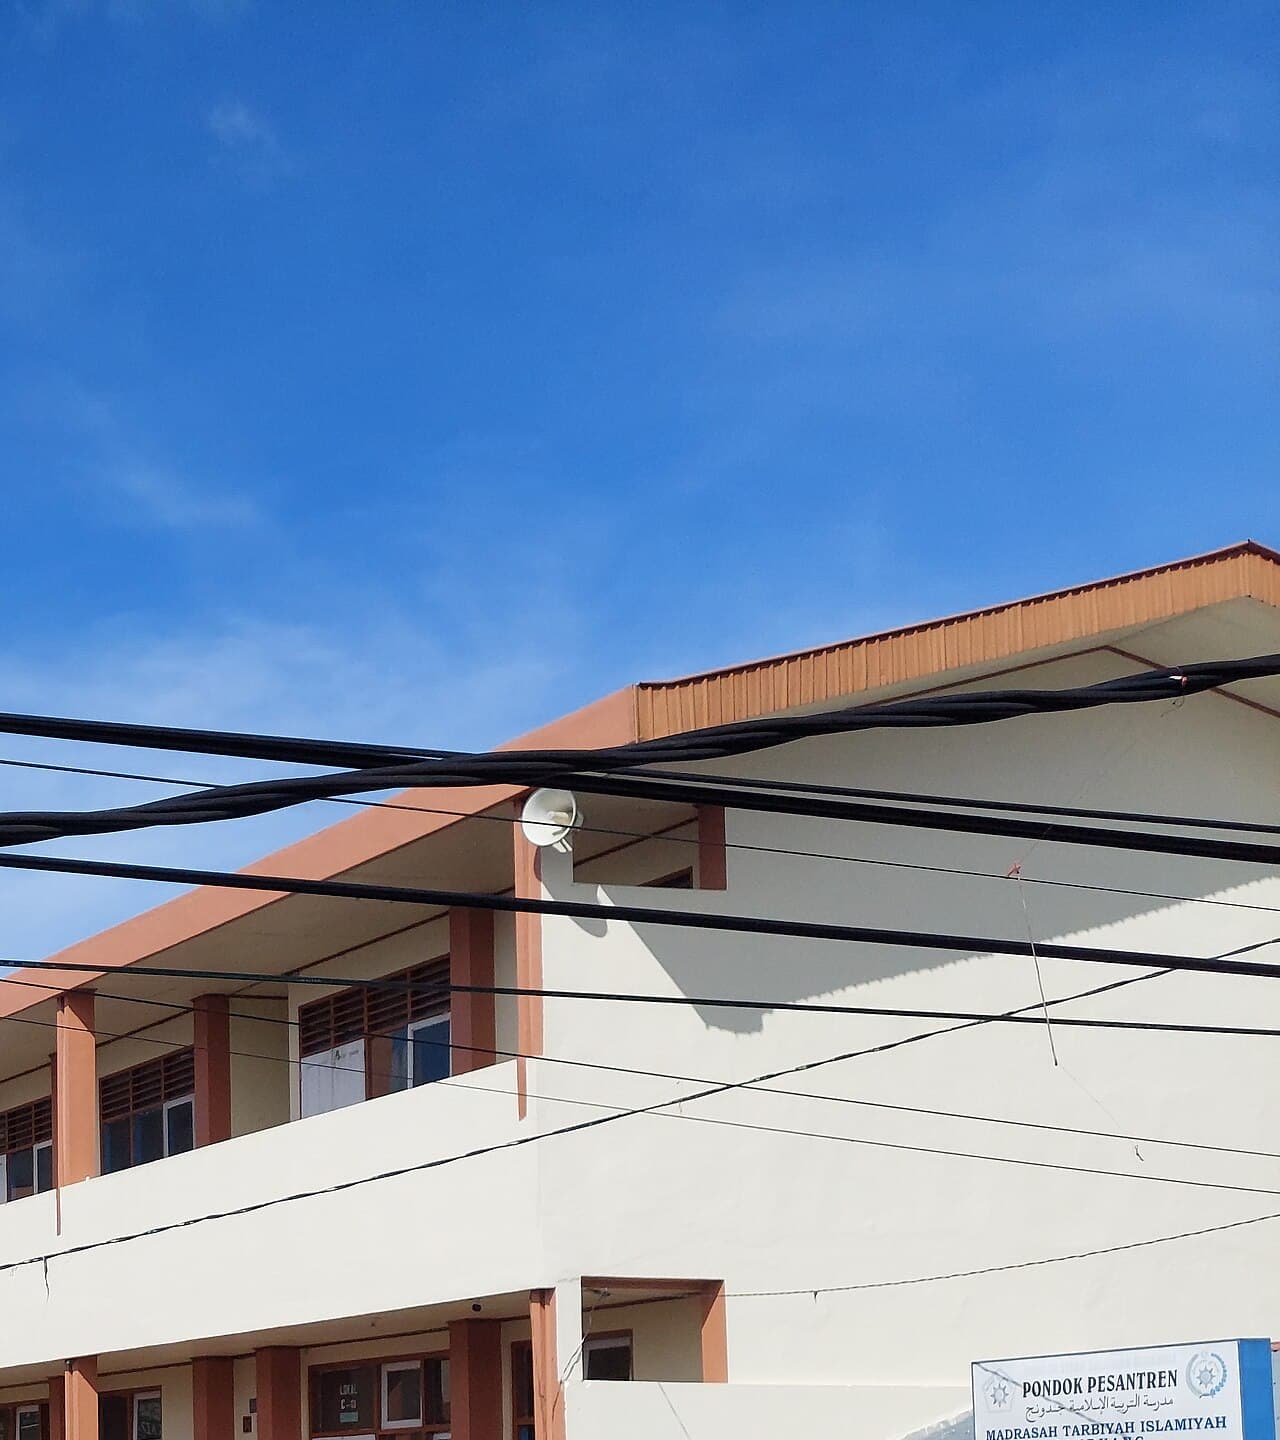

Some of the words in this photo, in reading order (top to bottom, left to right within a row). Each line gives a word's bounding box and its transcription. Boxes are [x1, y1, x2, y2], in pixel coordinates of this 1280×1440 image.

[1022, 1378, 1083, 1398] PONDOK
[1087, 1369, 1177, 1393] PESANTREN
[1062, 1421, 1135, 1438] TARBIYAH
[1141, 1416, 1227, 1433] ISLAMIYAH
